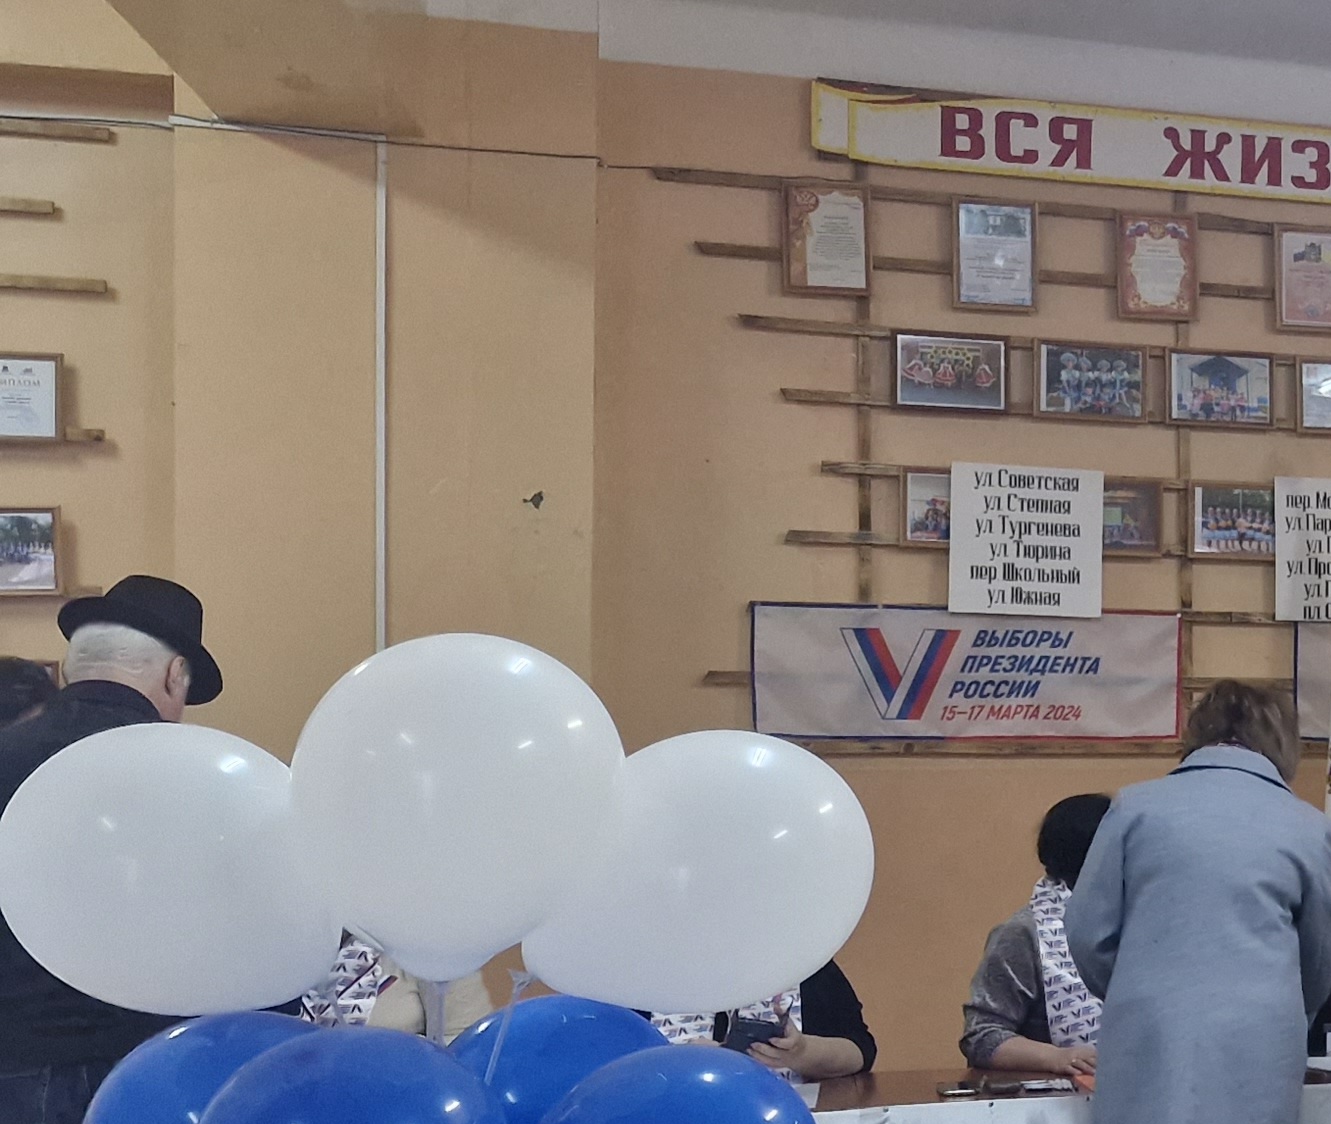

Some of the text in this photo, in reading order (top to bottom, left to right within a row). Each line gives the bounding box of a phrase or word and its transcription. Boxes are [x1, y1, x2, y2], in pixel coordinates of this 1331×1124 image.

[938, 105, 1094, 170] ВСЯ
[998, 468, 1080, 492] Советская
[1007, 493, 1072, 515] Степная
[998, 514, 1081, 540] Тургенева
[1013, 540, 1071, 563] Тюрина
[1002, 562, 1080, 584] Школьный
[1010, 586, 1061, 606] Южная
[971, 629, 1074, 648] ВЫБОРЫ
[960, 655, 1101, 676] ПРЕЗИДЕНТА
[948, 680, 1041, 699] РОССИИ
[985, 704, 1041, 720] МАРТА
[1042, 705, 1082, 721] 2024
